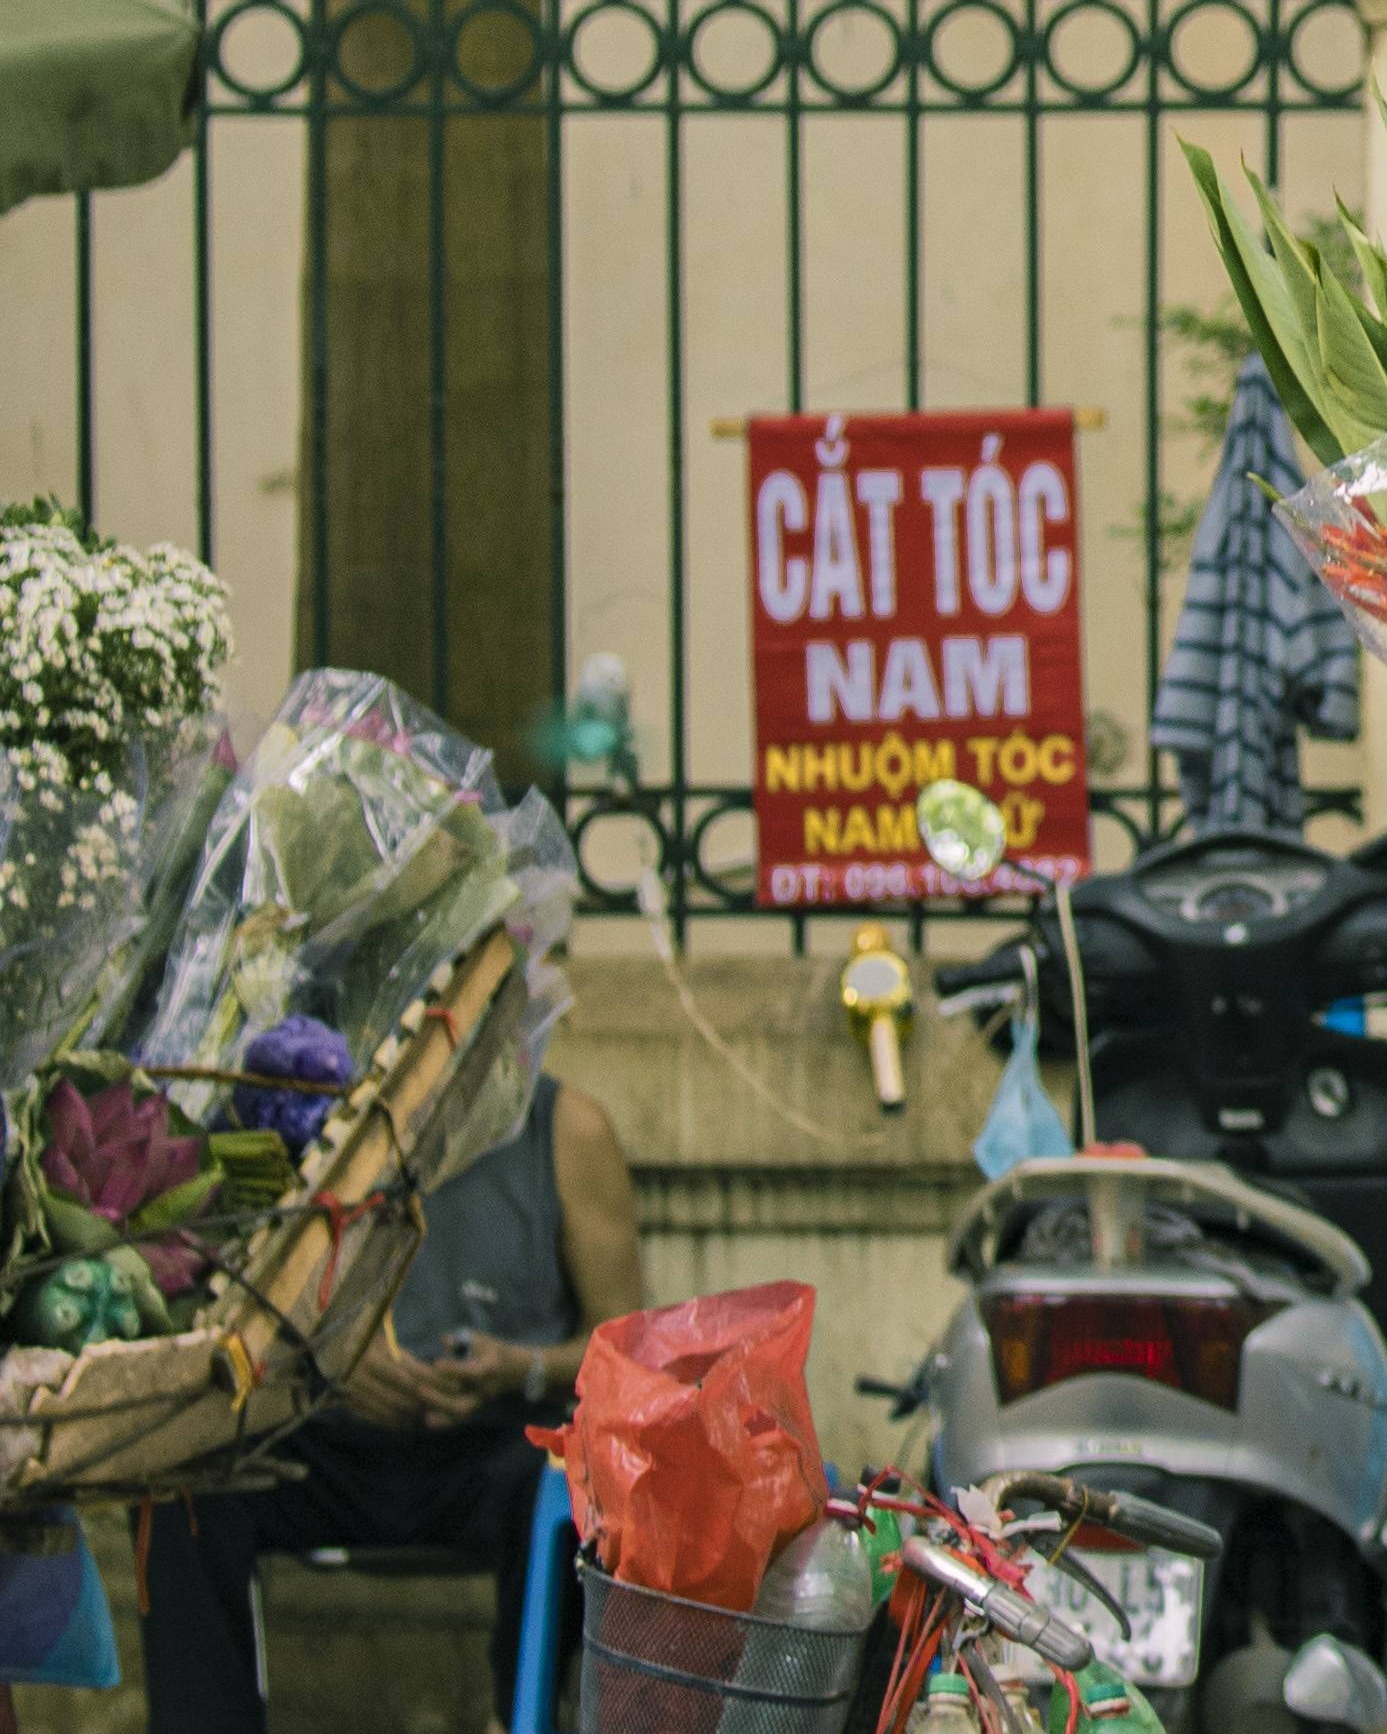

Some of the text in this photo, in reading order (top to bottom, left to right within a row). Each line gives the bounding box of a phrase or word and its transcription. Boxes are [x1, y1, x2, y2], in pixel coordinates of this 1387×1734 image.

[757, 415, 1071, 624] CẮT TÓC
[805, 636, 1029, 723] NAM
[765, 724, 1077, 799] NHUỘM TÓC
[803, 804, 922, 856] NAM
